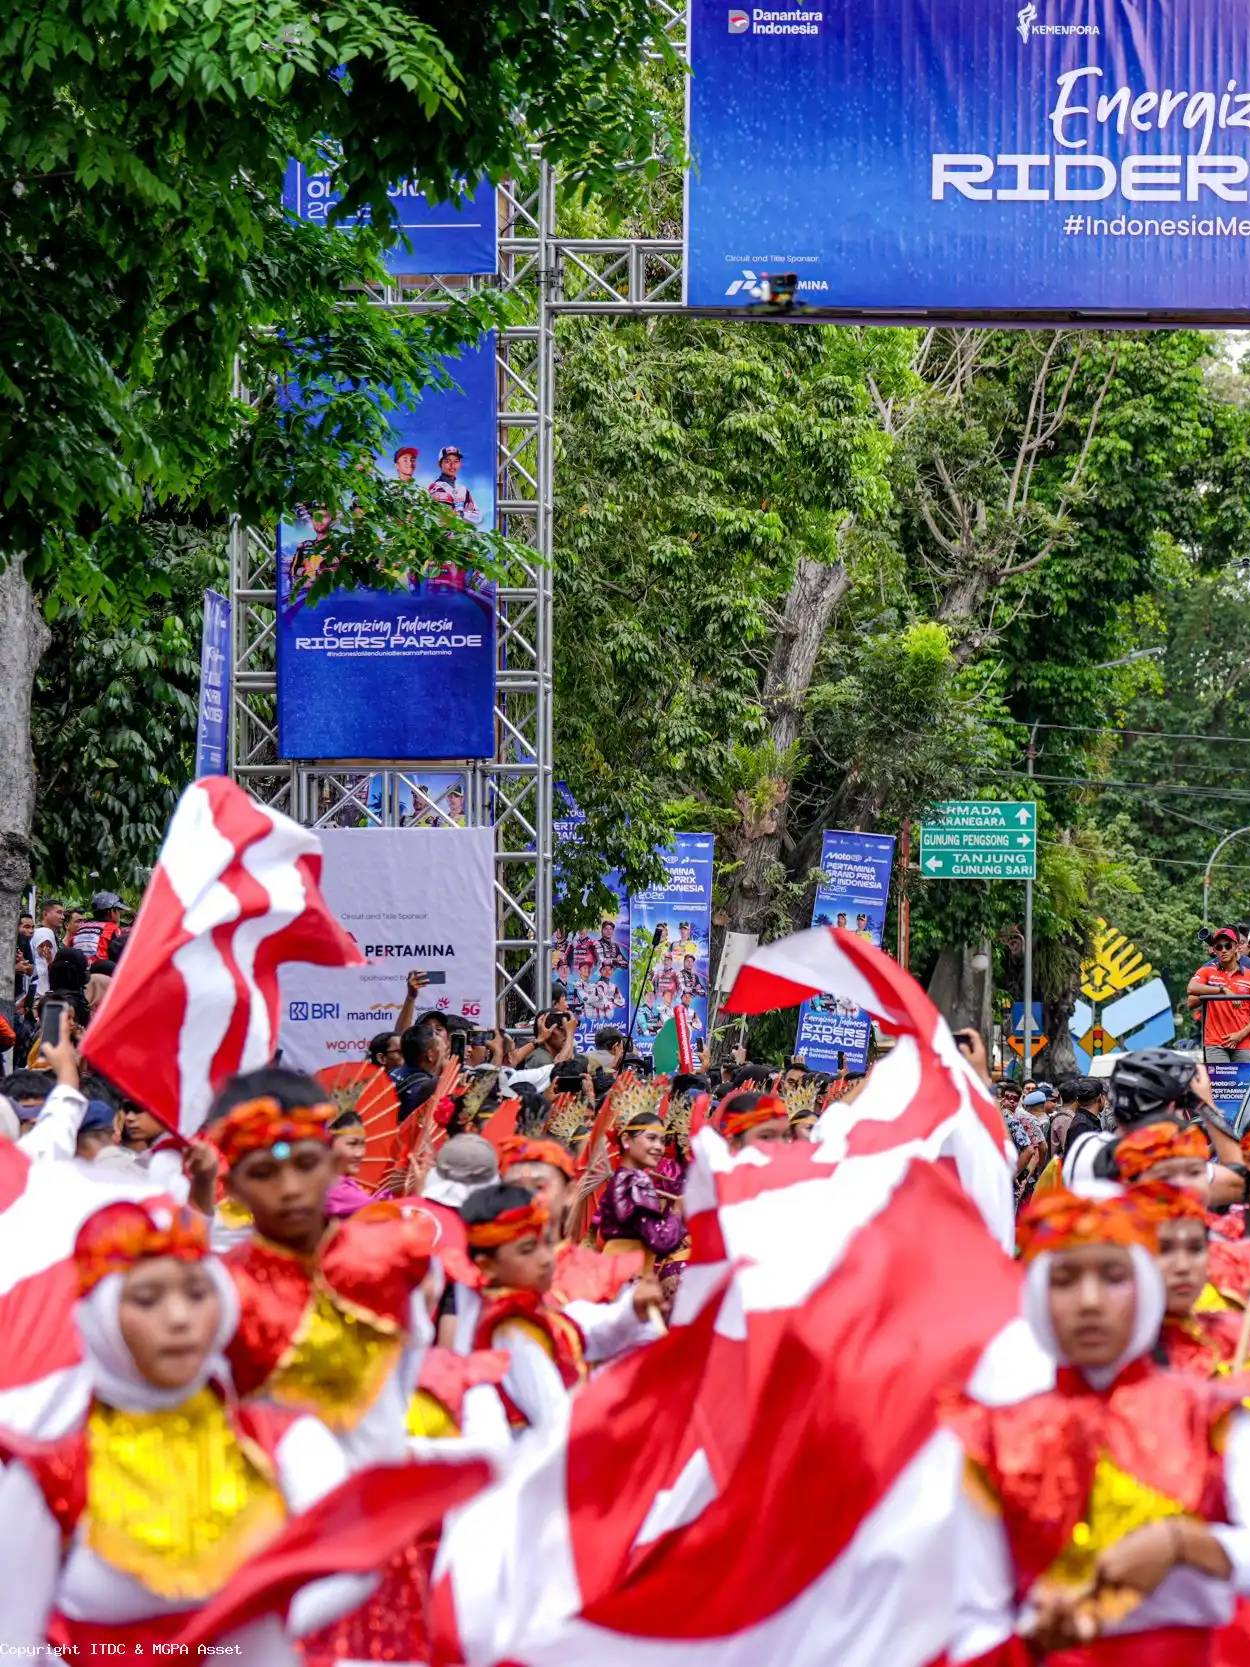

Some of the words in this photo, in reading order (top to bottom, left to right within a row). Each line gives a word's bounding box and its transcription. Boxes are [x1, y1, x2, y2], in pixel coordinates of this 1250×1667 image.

[752, 8, 823, 22] Danantara
[752, 22, 819, 35] Indonesia
[1031, 25, 1100, 35] KEMENPORA
[322, 616, 392, 640] Energizing
[395, 615, 453, 637] Indonesia
[295, 636, 387, 650] RIDERS
[389, 634, 483, 648] PARADE
[923, 833, 960, 847] GUNUNG
[962, 834, 1009, 847] PENGSONG
[952, 853, 1027, 865] TANJUNG
[826, 861, 876, 874] PERTAMINA
[951, 865, 1002, 876] GUNUNG
[1005, 865, 1033, 875] SARI
[673, 875, 697, 884] PRIX
[825, 869, 856, 879] GRAND
[856, 872, 877, 882] PRIX
[652, 883, 705, 894] INDONESIA
[837, 878, 883, 890] INDONESIA
[638, 891, 666, 901] 2026
[364, 944, 456, 958] PERTAMINA
[311, 1003, 340, 1020] BRI
[346, 1009, 393, 1021] mandiri
[461, 1003, 481, 1016] 5G
[801, 1023, 867, 1040] RIDERS
[800, 1032, 866, 1049] PARADE
